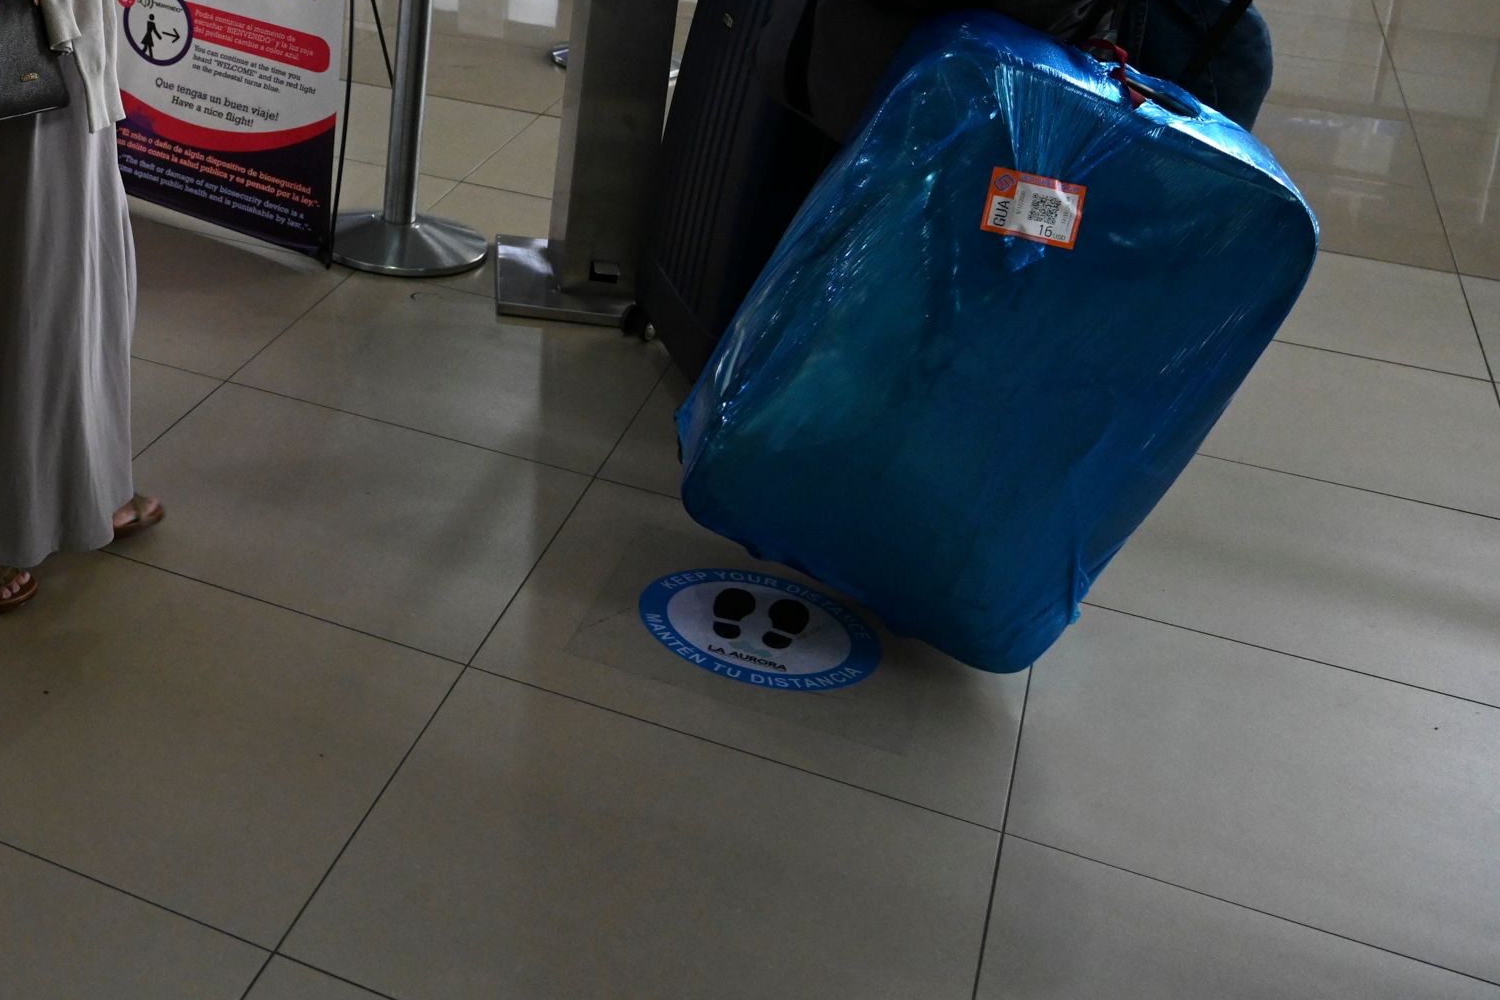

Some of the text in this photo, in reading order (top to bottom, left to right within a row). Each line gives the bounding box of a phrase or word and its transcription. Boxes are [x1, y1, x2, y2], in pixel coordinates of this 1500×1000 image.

[155, 77, 279, 121] Que tengas un buen viaje!
[171, 95, 194, 110] Have
[203, 106, 224, 119] nice
[225, 112, 254, 127] flight!
[993, 200, 1011, 227] GUA
[1038, 224, 1053, 238] 16
[660, 570, 872, 641] KEEP YOUR DISTANCE
[708, 644, 787, 672] LA AURORA
[713, 661, 741, 679] TU
[750, 666, 864, 690] DISTANCIA
